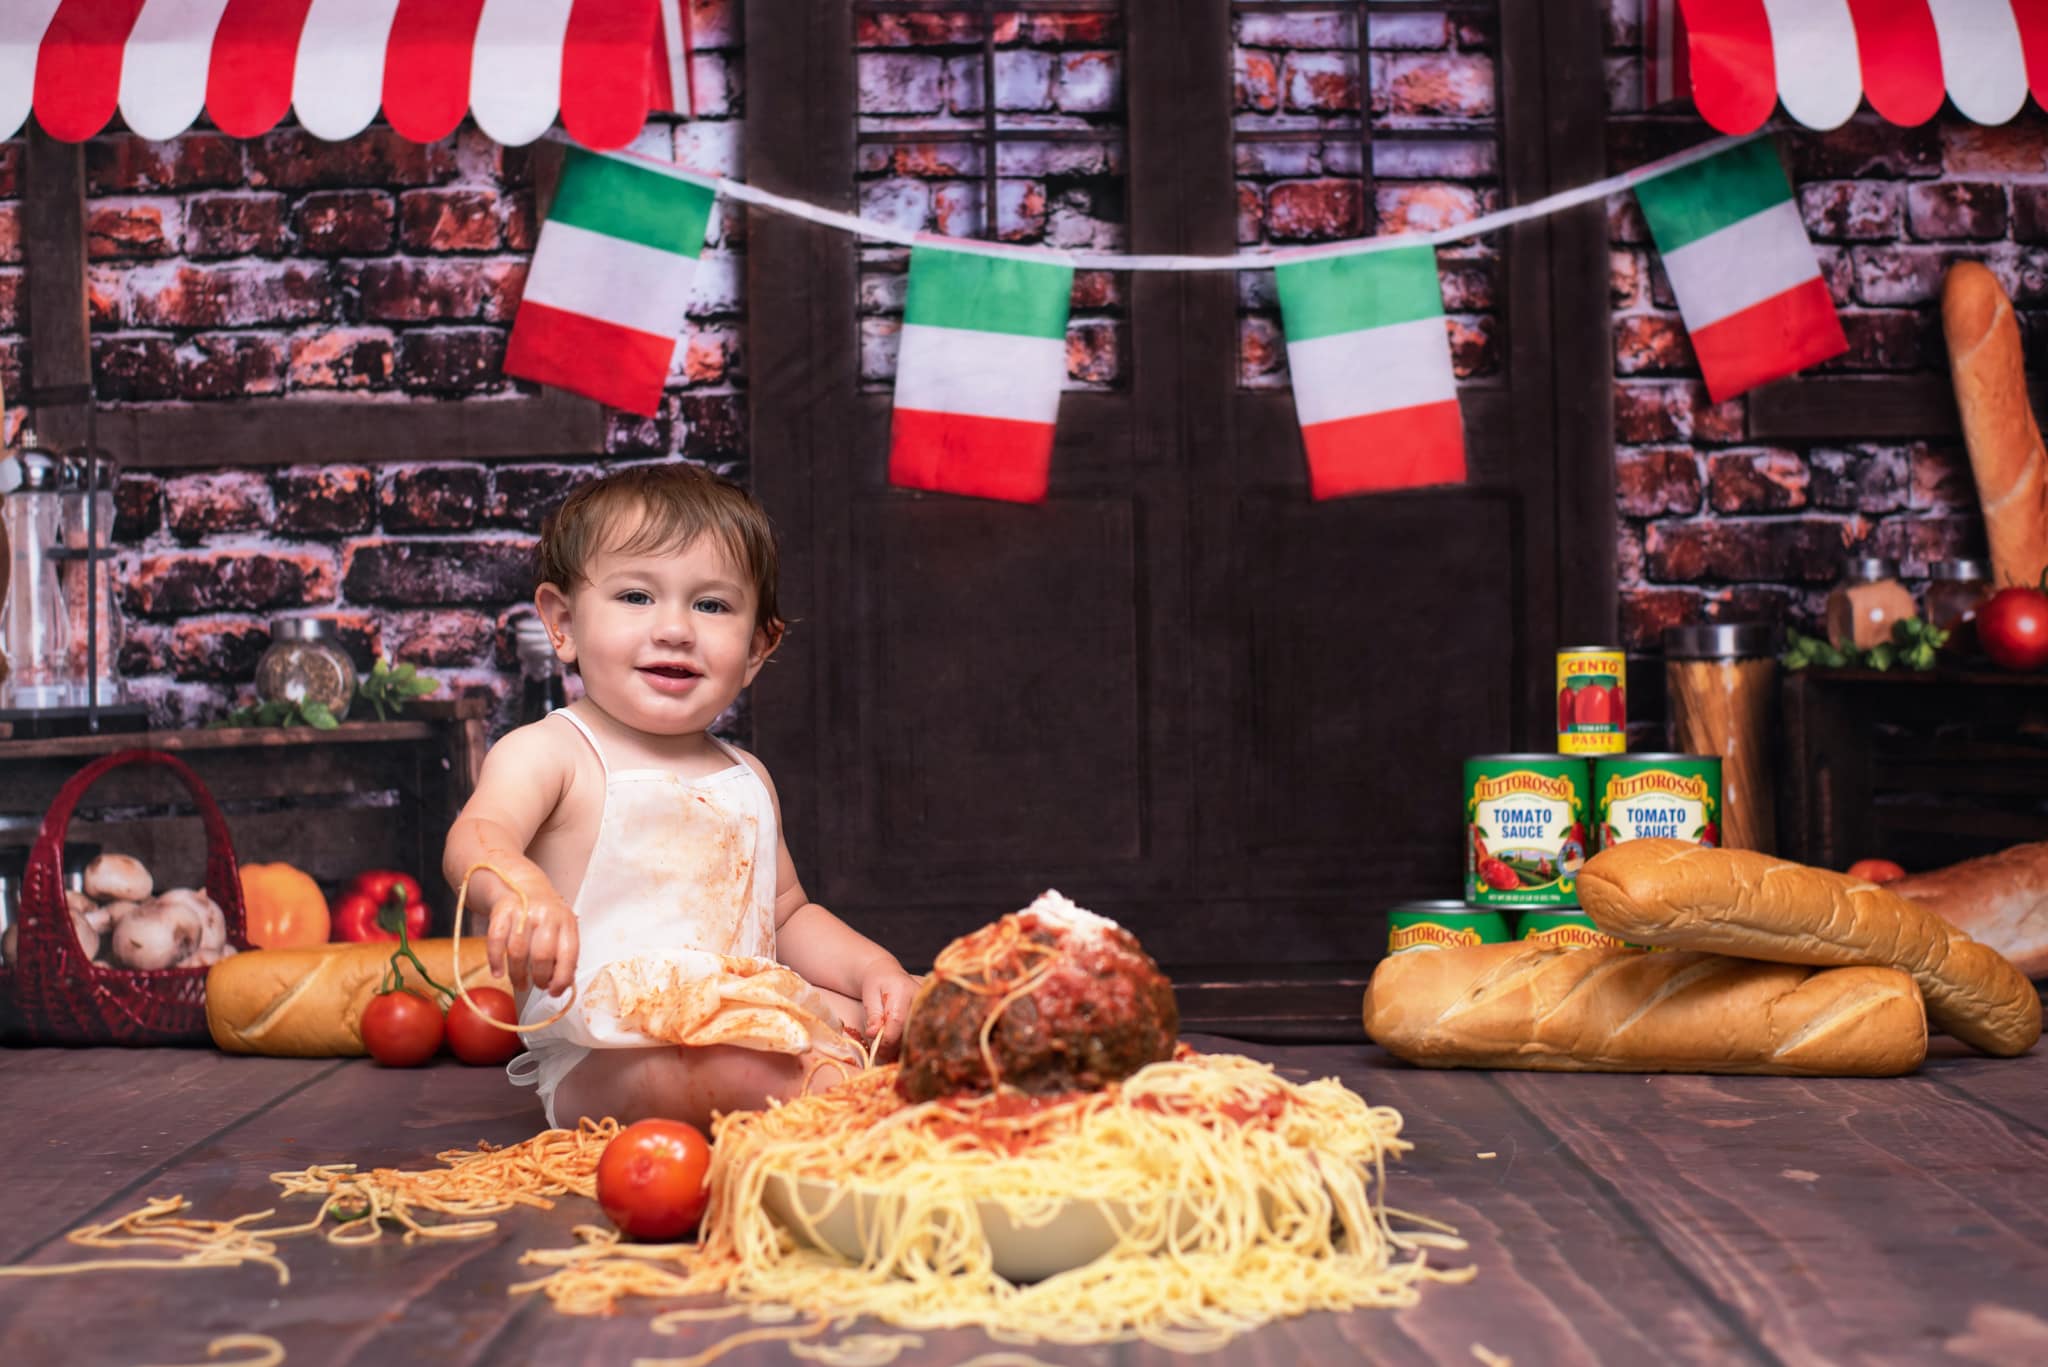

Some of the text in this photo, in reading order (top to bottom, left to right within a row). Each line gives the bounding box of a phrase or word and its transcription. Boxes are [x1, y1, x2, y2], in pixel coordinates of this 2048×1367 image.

[1567, 660, 1618, 674] CENTO
[1571, 735, 1613, 745] PASTE
[1480, 774, 1568, 797] TUTTOROSSO
[1612, 774, 1700, 797] TUTTOROSSO
[1493, 808, 1552, 824] TOMATO
[1626, 807, 1686, 823] TOMATO
[1501, 825, 1544, 839] SAUCE
[1635, 825, 1678, 838] SAUCE
